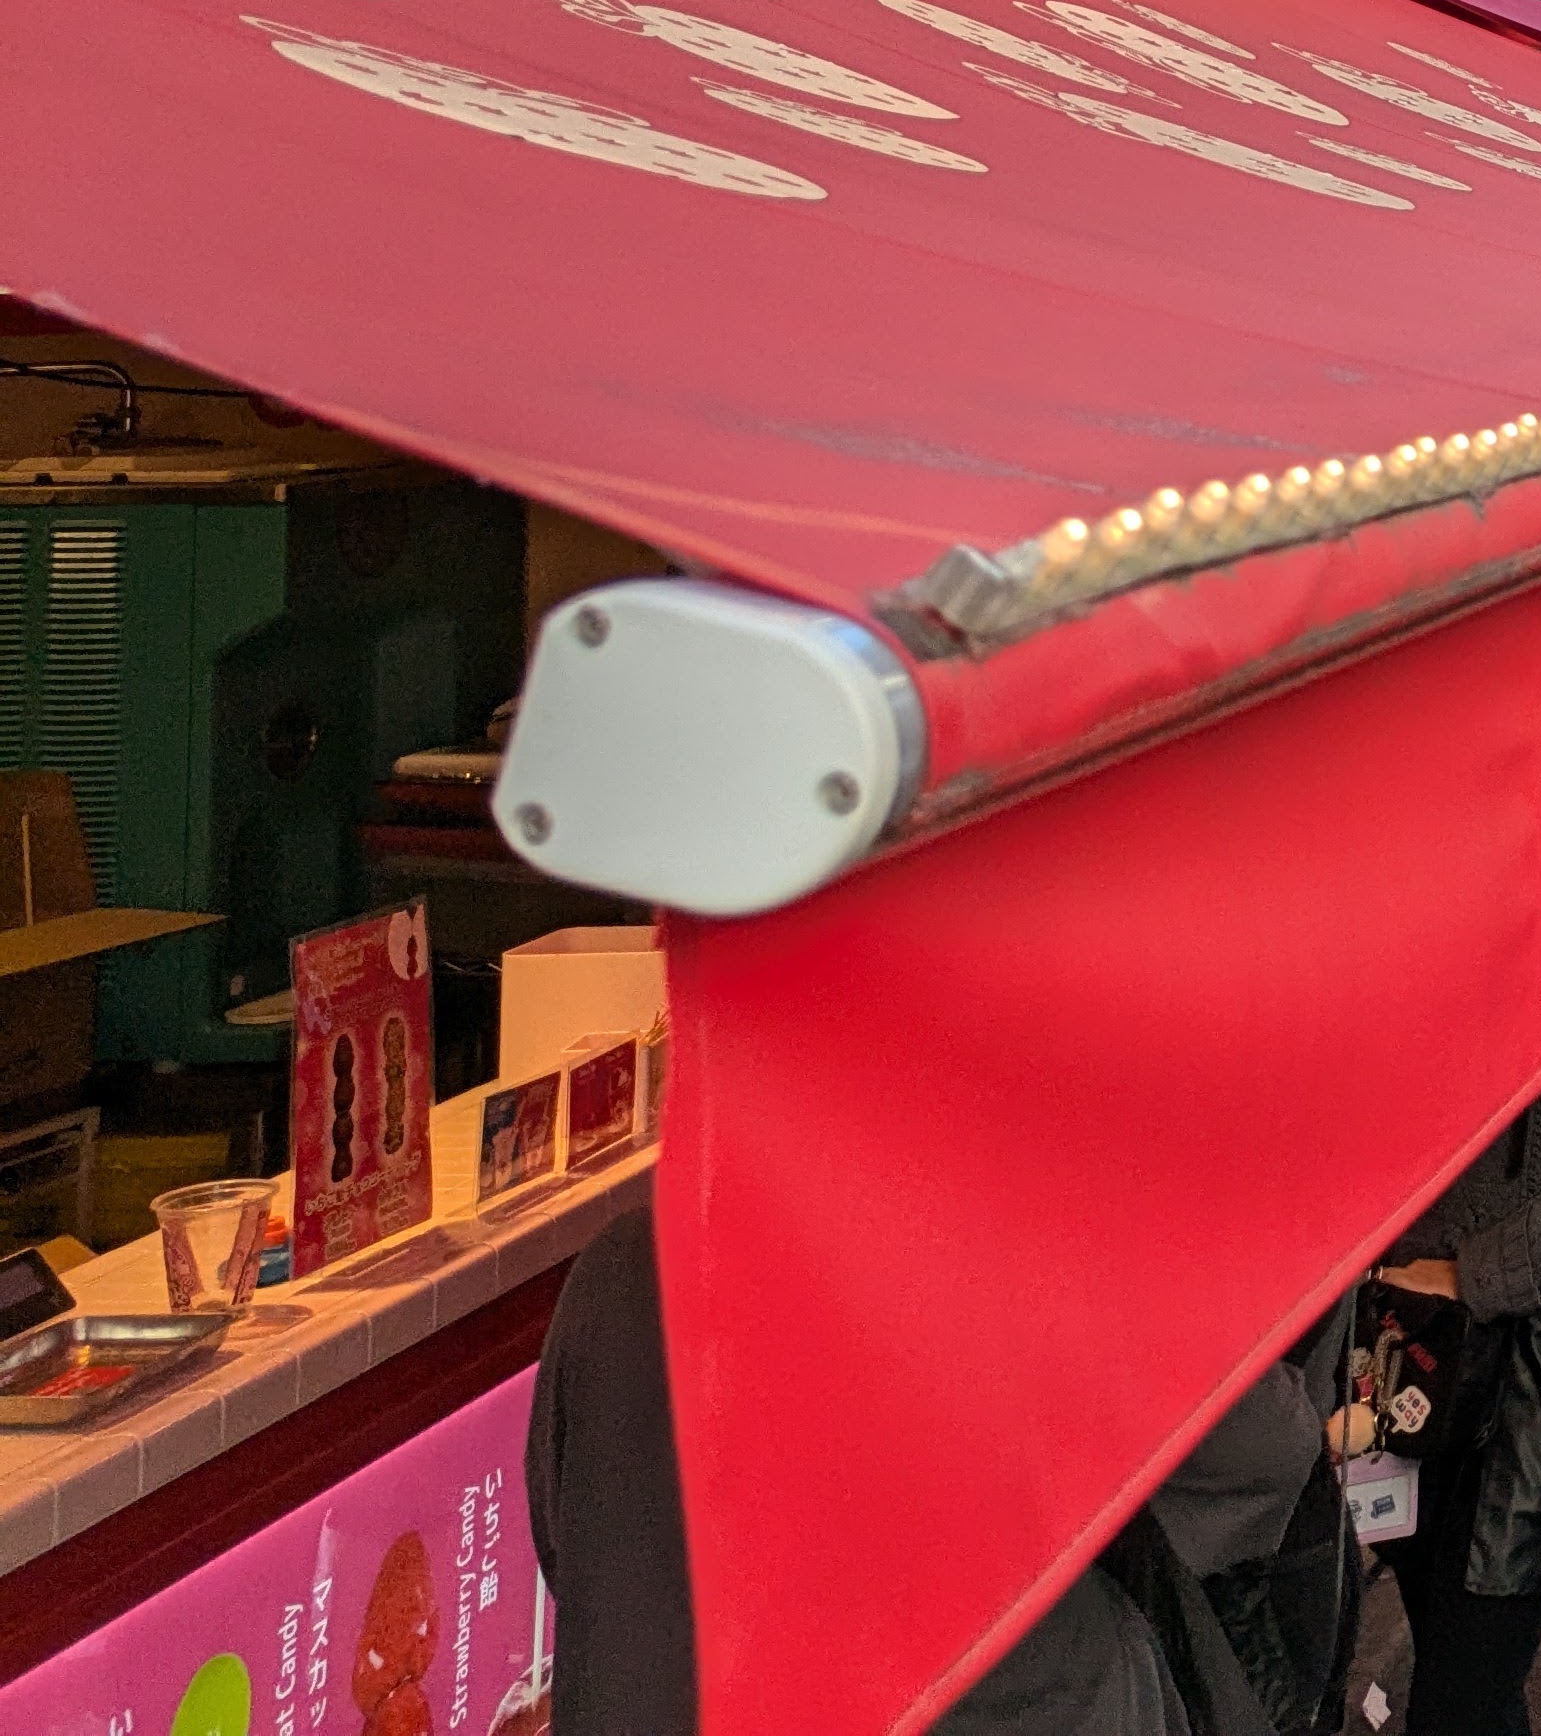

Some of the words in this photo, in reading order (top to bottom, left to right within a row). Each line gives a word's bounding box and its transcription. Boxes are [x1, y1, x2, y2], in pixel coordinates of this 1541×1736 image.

[456, 1485, 481, 1568] Candy
[275, 1604, 304, 1700] Candy
[449, 1573, 476, 1730] Strawberry
[275, 1703, 295, 1736] at
